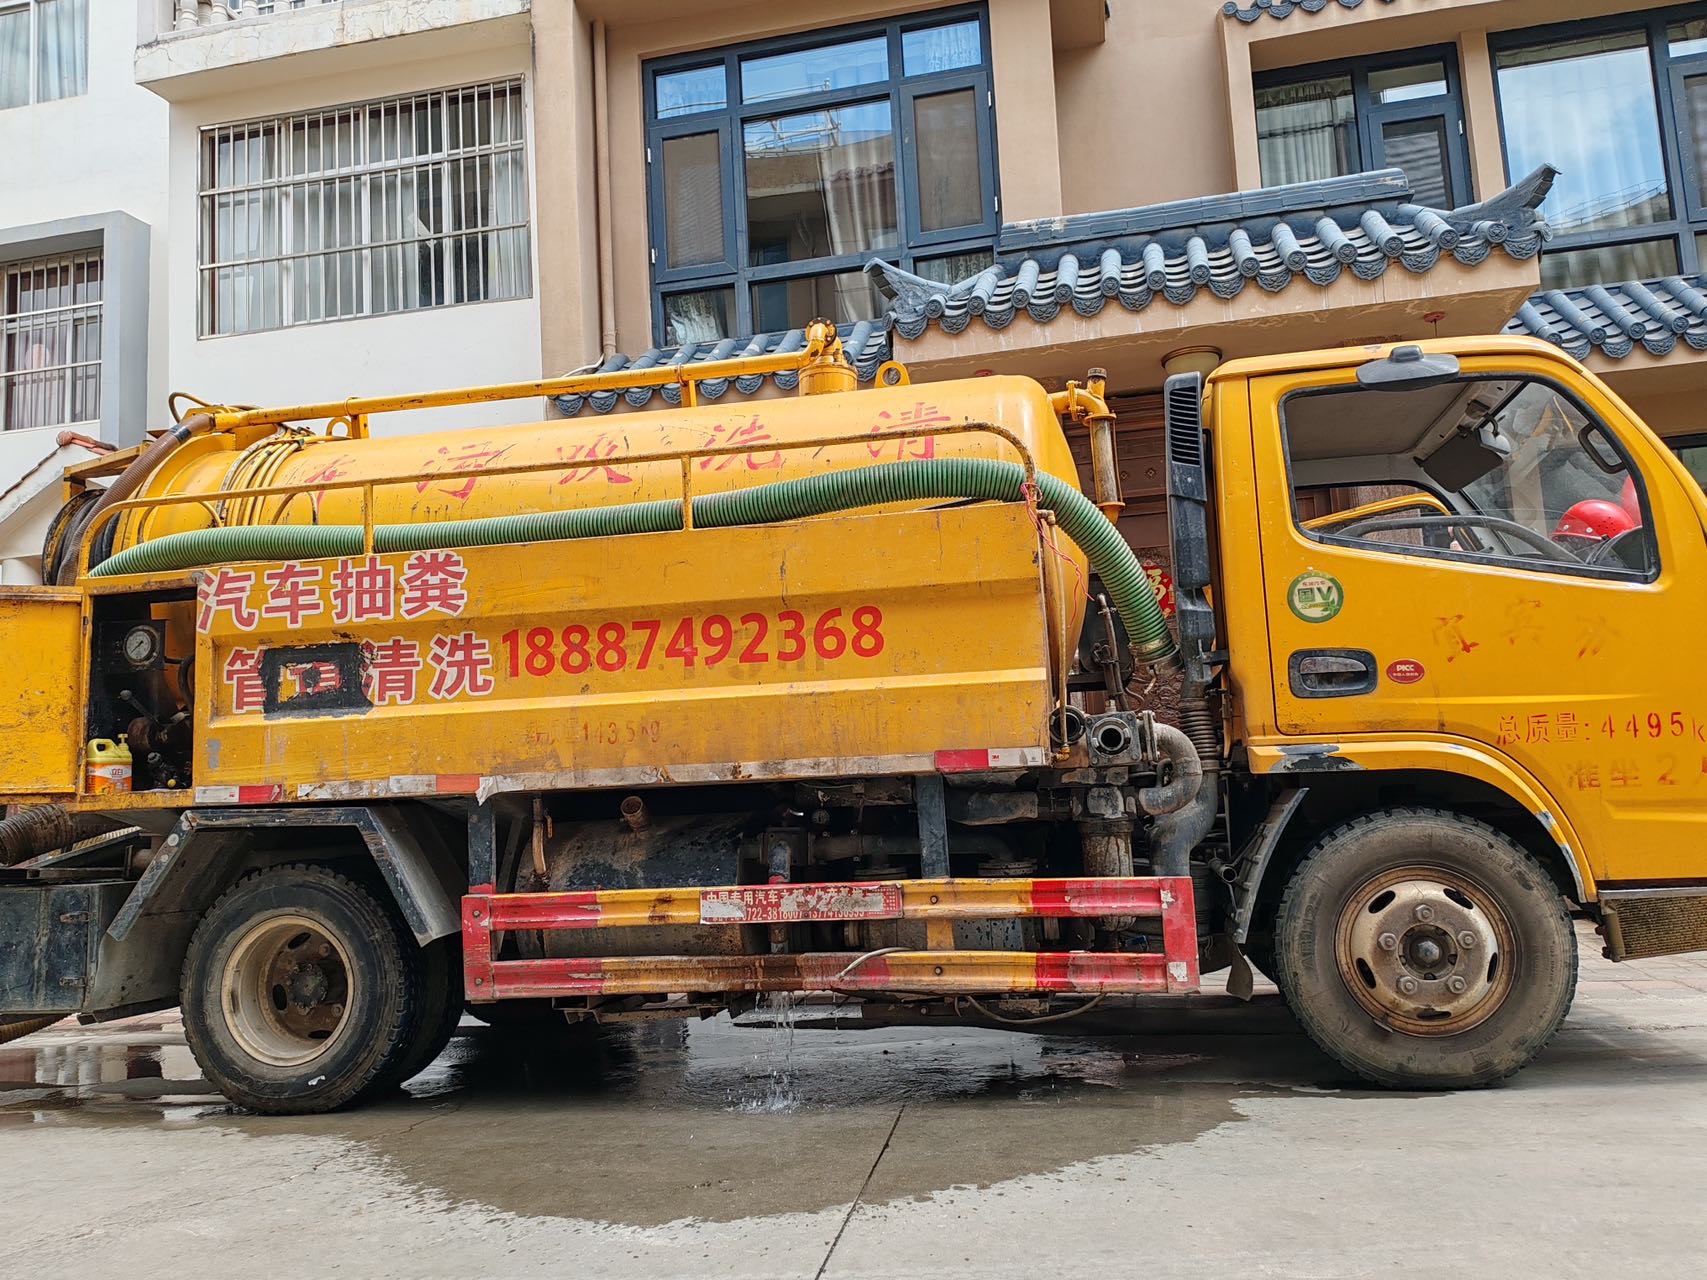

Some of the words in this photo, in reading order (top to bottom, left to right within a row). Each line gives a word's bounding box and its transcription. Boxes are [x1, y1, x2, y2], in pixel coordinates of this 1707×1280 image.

[197, 549, 469, 633] 汽车抽粪
[501, 604, 885, 679] 18887492368
[1396, 664, 1416, 672] PICC
